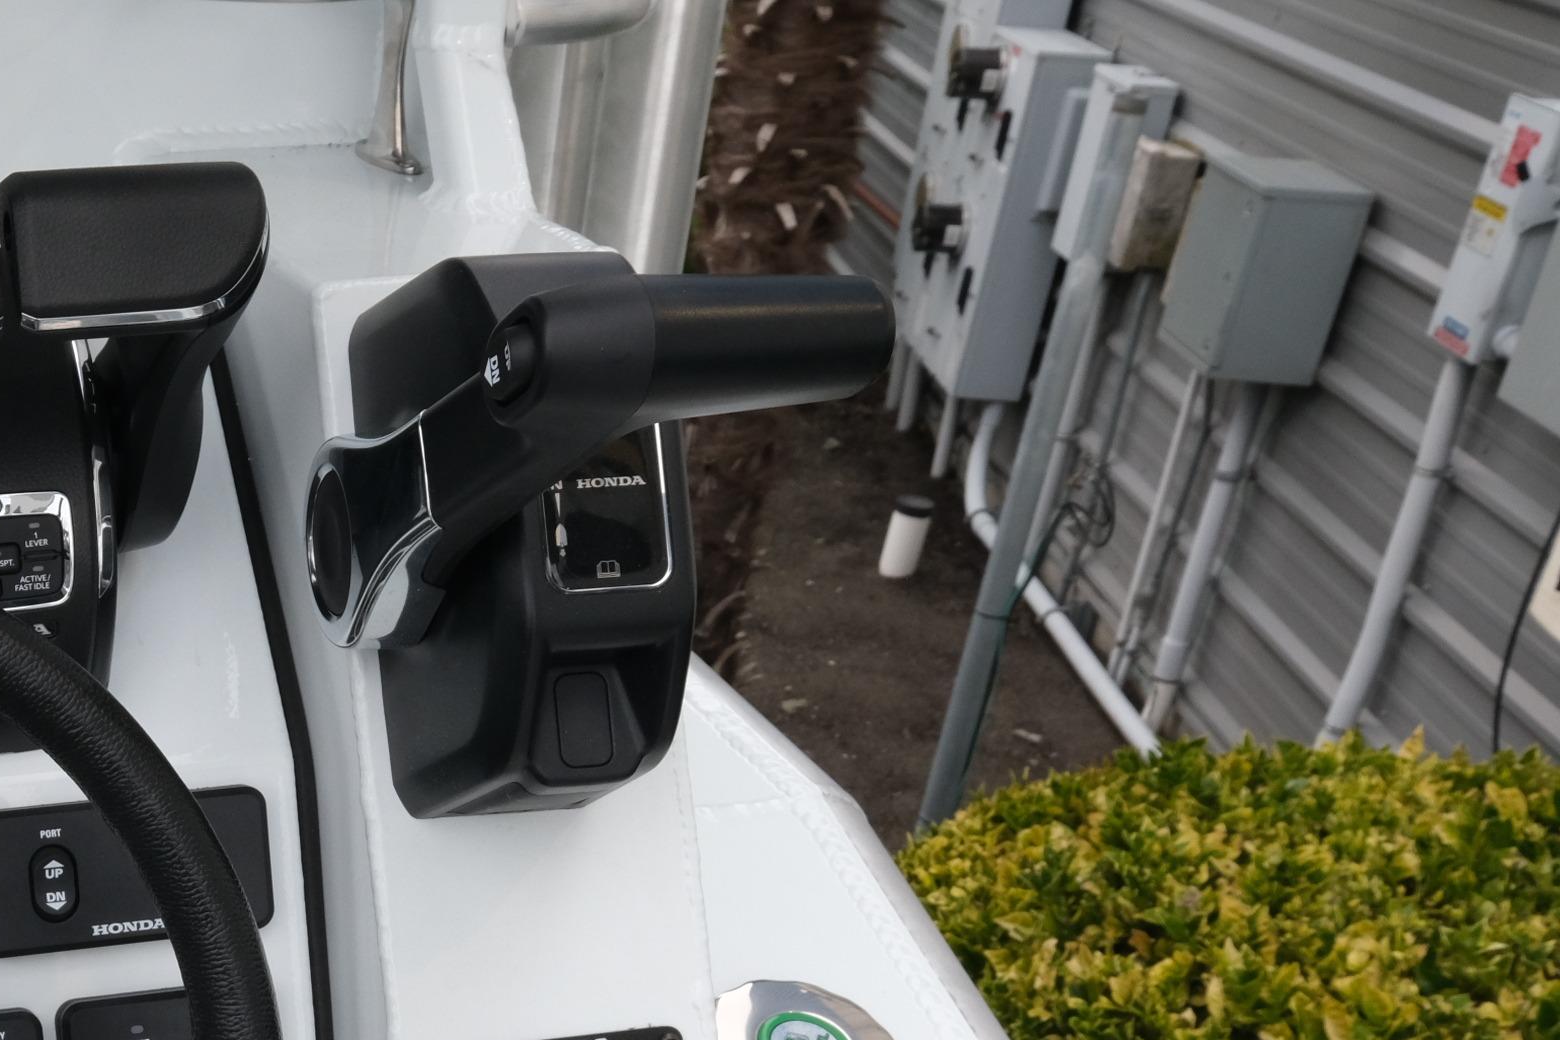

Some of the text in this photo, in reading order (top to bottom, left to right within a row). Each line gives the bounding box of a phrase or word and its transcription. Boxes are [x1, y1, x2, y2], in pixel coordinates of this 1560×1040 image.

[490, 354, 501, 385] DN
[576, 475, 647, 489] HONDA
[24, 538, 49, 548] LEVER
[19, 573, 51, 583] ACTIVE/
[14, 581, 50, 592] FAST IDLE
[40, 828, 62, 839] PORT
[45, 869, 64, 880] UP
[46, 891, 66, 903] DN
[92, 917, 167, 936] HONDA
